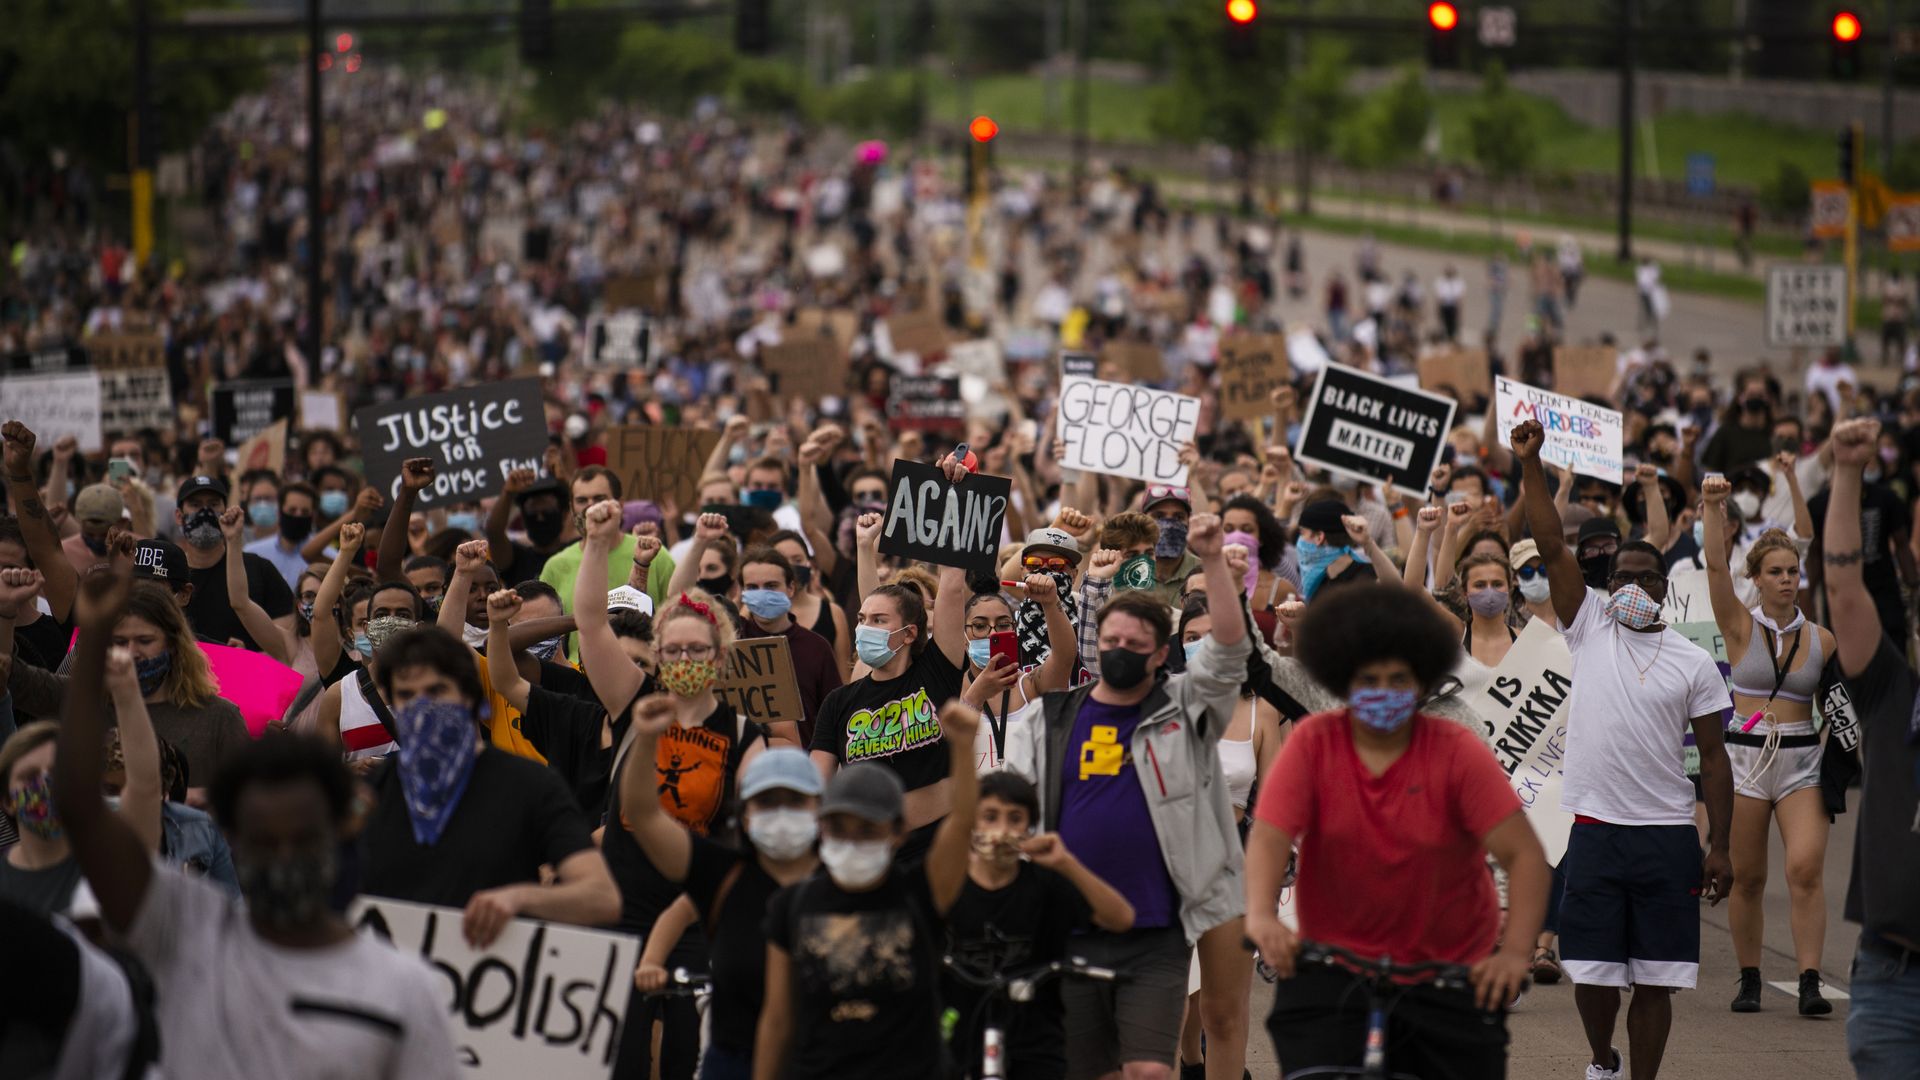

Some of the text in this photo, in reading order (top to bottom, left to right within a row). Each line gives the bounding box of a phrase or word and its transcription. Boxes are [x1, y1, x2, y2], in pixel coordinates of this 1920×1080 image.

[1780, 273, 1832, 292] LEFT
[1779, 297, 1837, 316] TURN
[1776, 319, 1834, 339] LANE
[1499, 381, 1512, 395] I
[1062, 381, 1195, 444] GEORGE
[1322, 384, 1439, 438] BLACK LIVES
[1513, 399, 1602, 439] MURDERS
[620, 427, 705, 470] FUCK
[1063, 423, 1183, 480] FLOYD
[1337, 426, 1406, 463] MATTER
[884, 475, 1007, 556] AGAIN?
[725, 643, 778, 680] ANT
[712, 684, 781, 719] TICE
[1487, 675, 1522, 709] IS
[848, 687, 932, 741] 90210
[1494, 668, 1571, 782] ERIKKKA
[848, 719, 940, 760] BEVERLY HILLS
